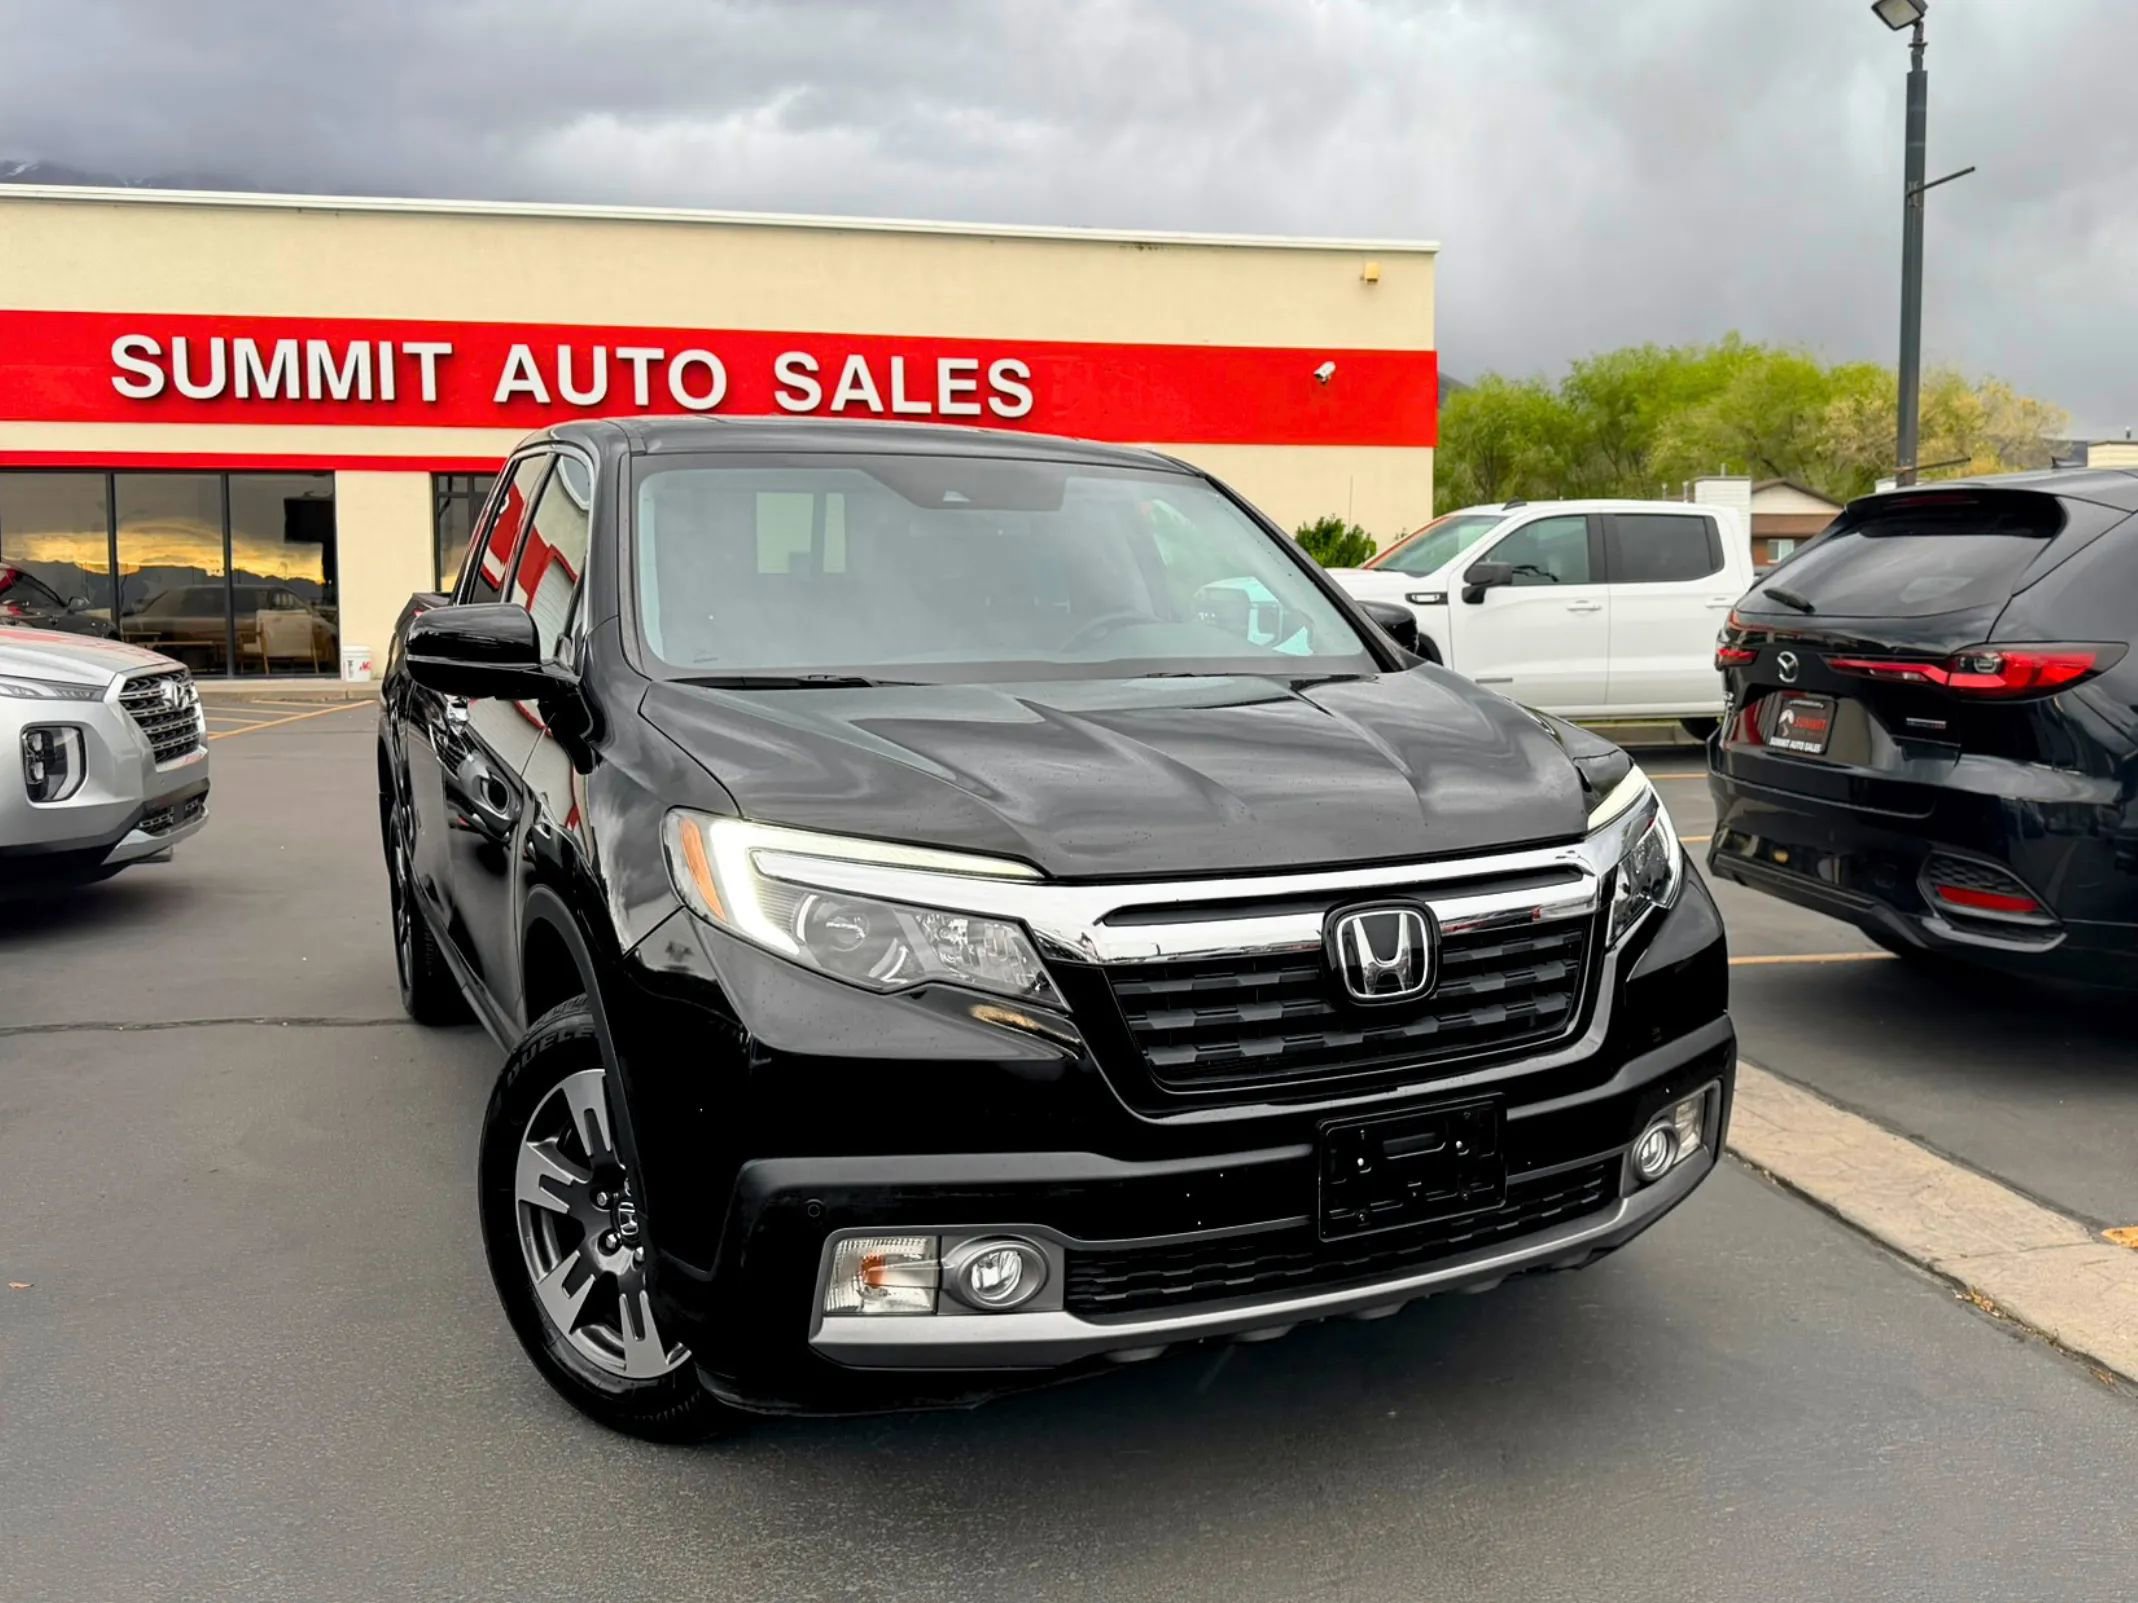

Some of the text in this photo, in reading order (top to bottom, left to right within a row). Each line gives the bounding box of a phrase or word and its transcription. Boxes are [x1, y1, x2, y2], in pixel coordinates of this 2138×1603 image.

[111, 334, 1034, 418] SUMMIT AUTO SALES
[507, 1022, 595, 1088] DUELE
